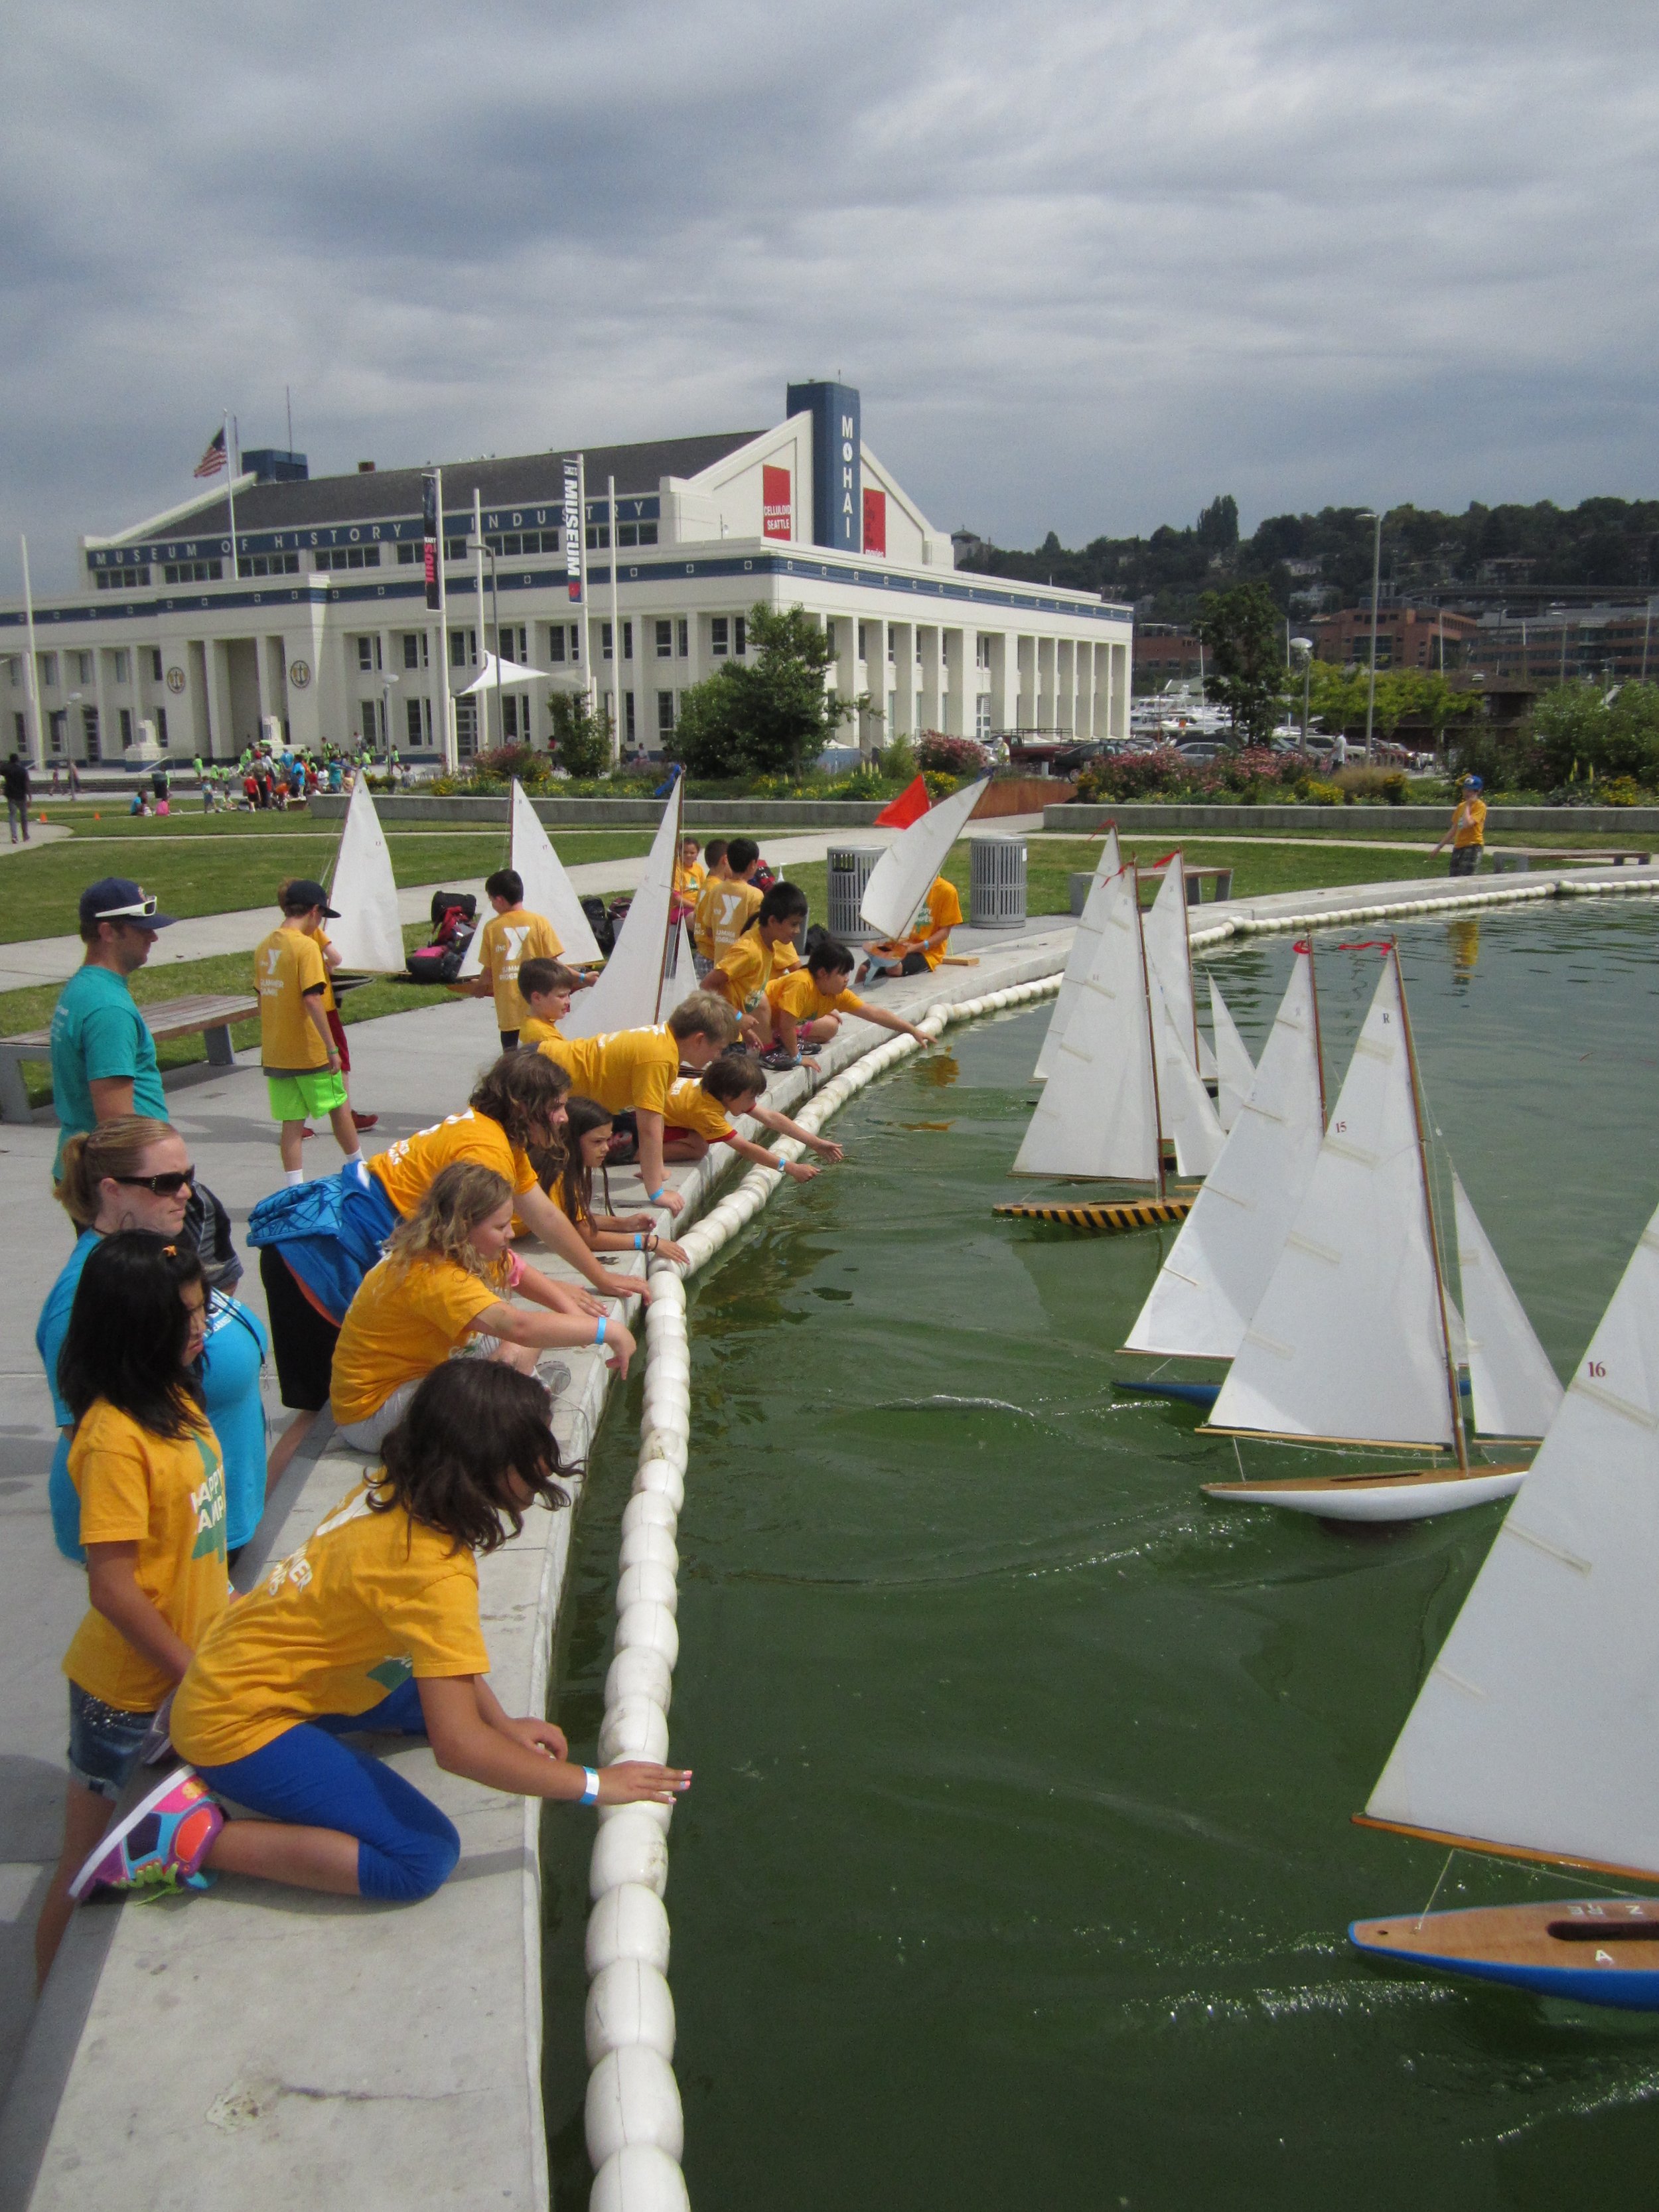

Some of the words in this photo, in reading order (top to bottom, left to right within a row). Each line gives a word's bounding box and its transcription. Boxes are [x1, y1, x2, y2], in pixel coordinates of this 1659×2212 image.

[841, 415, 853, 538] MOHAI
[764, 505, 790, 516] CELLULOID
[565, 479, 580, 576] MUSEUM
[767, 518, 790, 530] SEATTLE
[96, 543, 197, 565] MUSEUM
[221, 538, 249, 553] OF
[274, 524, 402, 548] HISTORY
[1382, 1013, 1390, 1024] R
[1336, 1121, 1347, 1133] 15
[1587, 1361, 1606, 1378] 16
